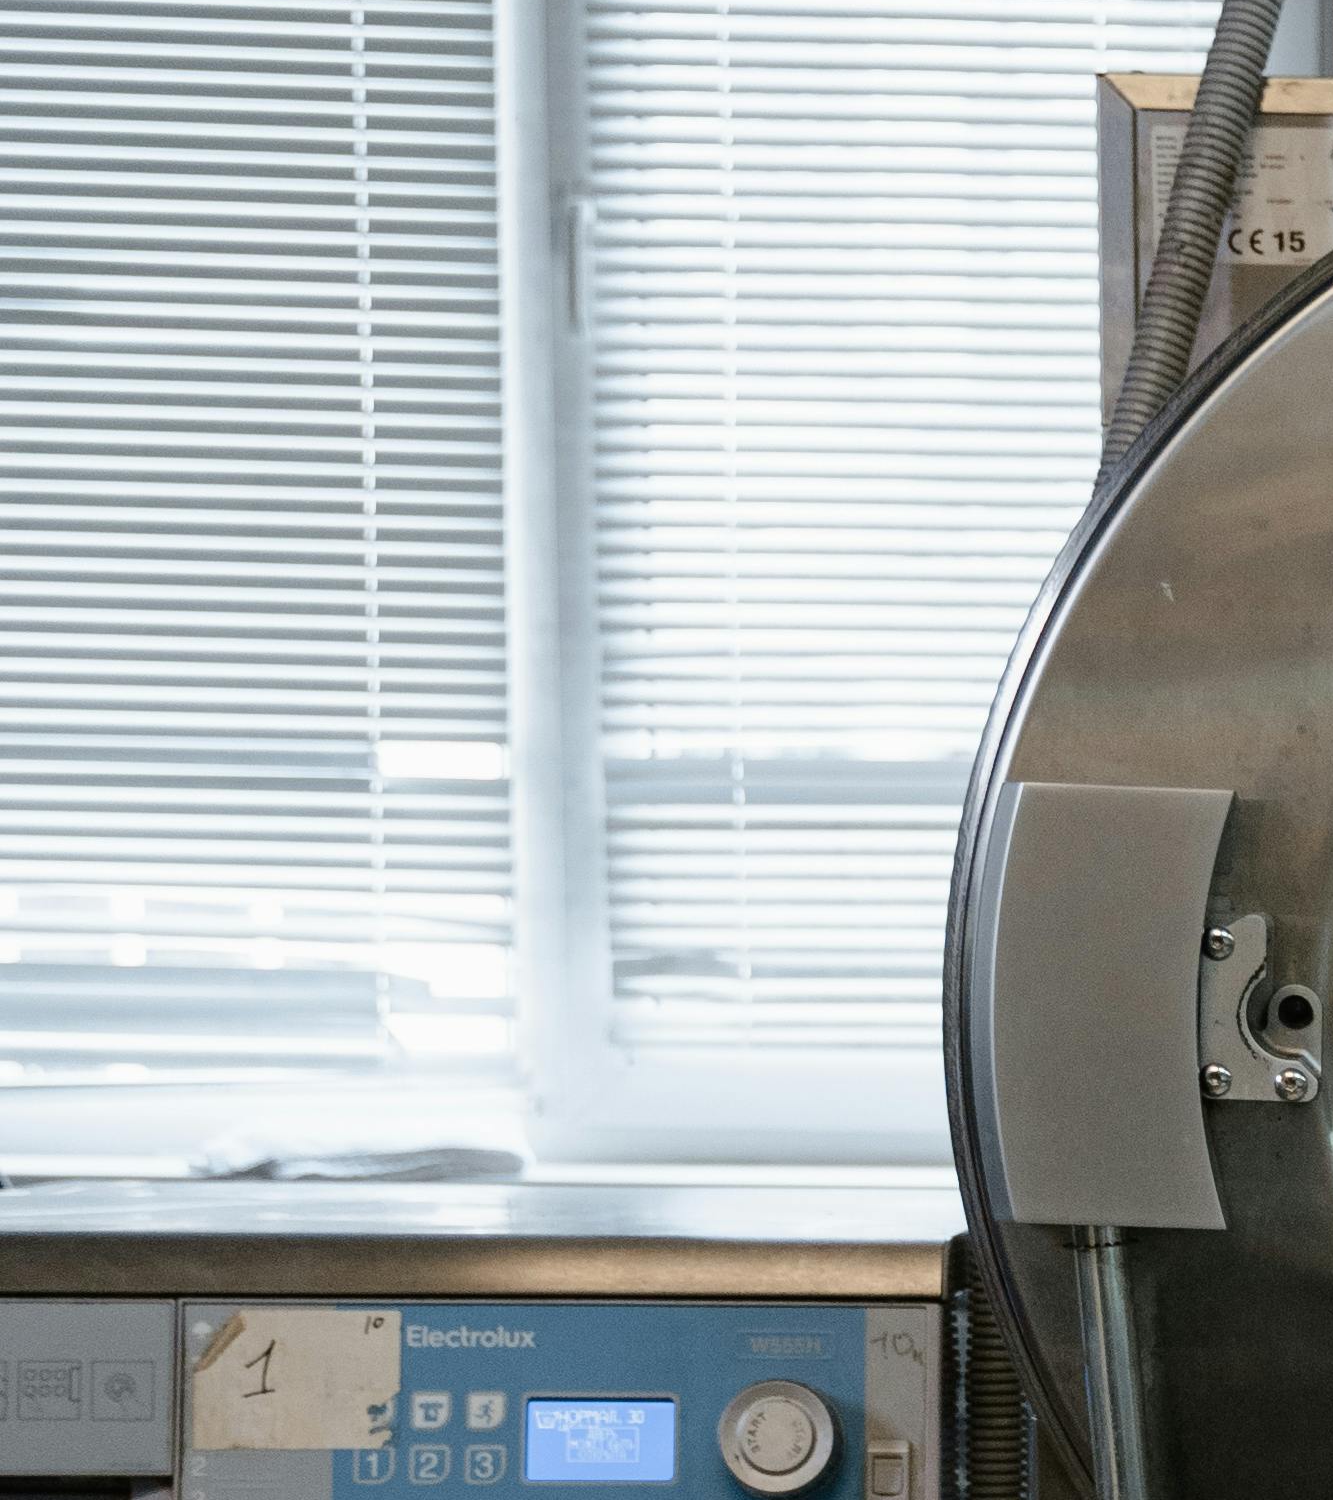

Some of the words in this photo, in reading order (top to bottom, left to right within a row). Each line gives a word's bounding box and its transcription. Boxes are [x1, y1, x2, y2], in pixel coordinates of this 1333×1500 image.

[1273, 230, 1306, 253] 15
[405, 1324, 537, 1349] Electrolux
[242, 1338, 277, 1399] 1
[190, 1455, 207, 1477] 2
[366, 1455, 379, 1477] 1
[419, 1454, 439, 1479] 2
[473, 1454, 495, 1479] 3
